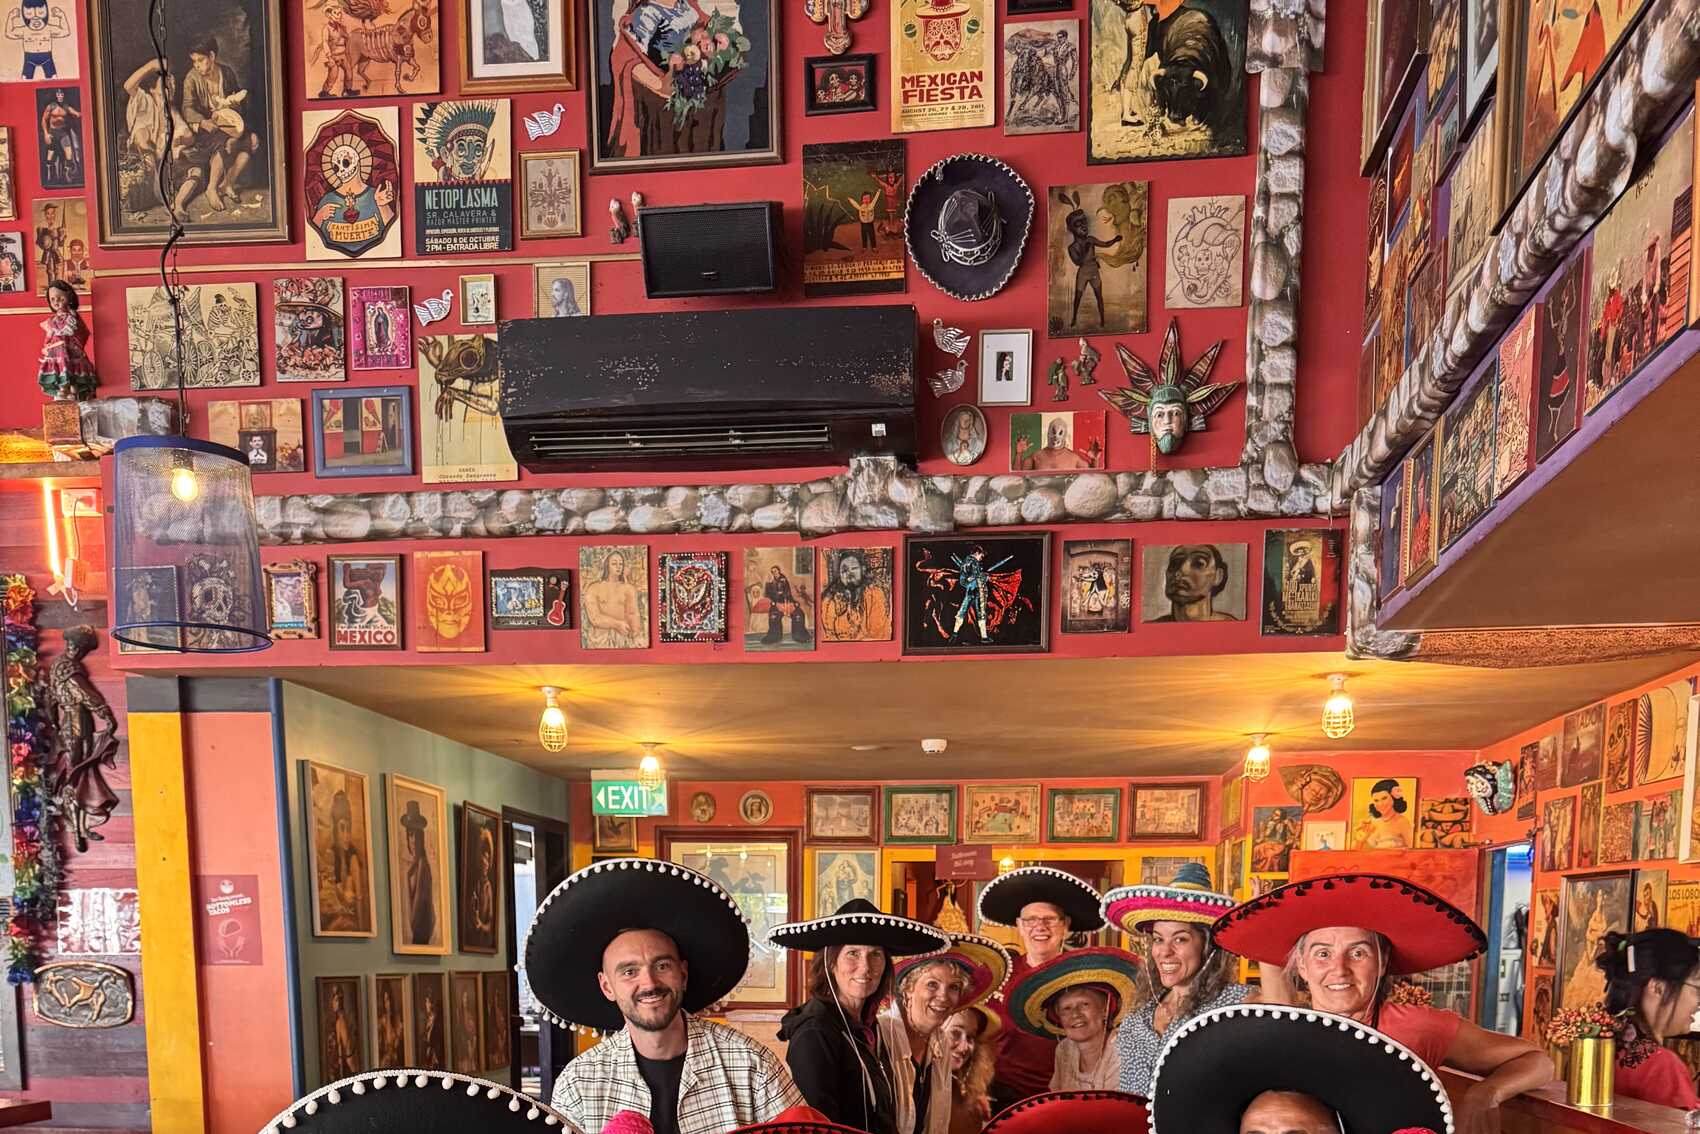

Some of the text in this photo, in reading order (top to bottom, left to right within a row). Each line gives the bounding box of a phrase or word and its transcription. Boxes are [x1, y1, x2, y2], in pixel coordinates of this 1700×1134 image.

[901, 70, 984, 89] MEXICAN
[902, 84, 984, 105] FIESTA
[425, 187, 498, 209] NETOPLASMA
[443, 209, 487, 219] CALAVERA
[335, 227, 375, 240] MUERTE
[469, 235, 500, 243] OCTUBRE
[425, 244, 430, 252] 2
[431, 243, 442, 252] PM
[447, 243, 478, 251] ENTRADA
[479, 240, 500, 250] LIBRE
[337, 630, 396, 643] MEXICO
[607, 785, 647, 809] EXIT
